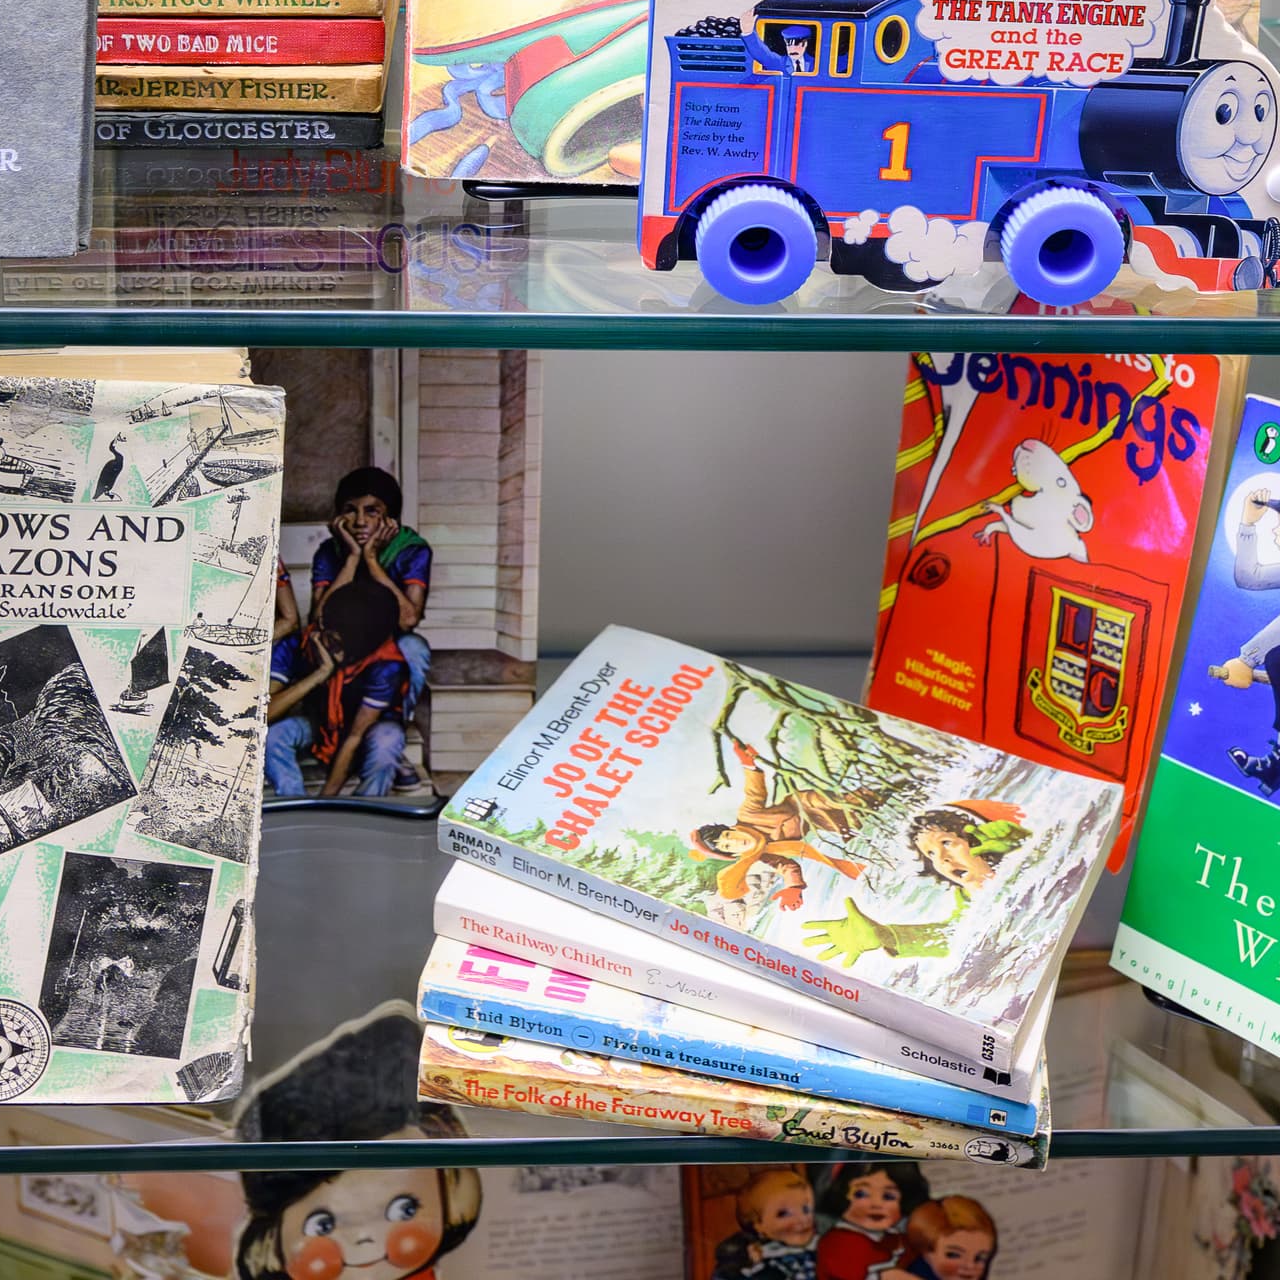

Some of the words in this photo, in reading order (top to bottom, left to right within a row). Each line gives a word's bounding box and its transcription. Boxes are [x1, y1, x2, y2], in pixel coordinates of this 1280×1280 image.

[933, 0, 983, 20] THE
[986, 1, 1052, 23] TANK
[1056, 3, 1146, 27] ENGINE
[122, 35, 170, 52] TWO
[178, 34, 218, 52] BAD
[226, 35, 278, 53] MICE
[991, 28, 1038, 44] and
[1046, 29, 1082, 45] the
[945, 49, 1039, 70] GREAT
[1047, 52, 1124, 73] RACE
[685, 102, 712, 114] Story
[716, 104, 740, 113] from
[683, 132, 710, 141] Series
[712, 133, 726, 144] by
[728, 134, 744, 142] the
[685, 117, 702, 126] The
[704, 118, 742, 130] Railway
[682, 146, 703, 155] Rev.
[708, 147, 720, 156] W.
[723, 149, 759, 160] Awdry
[880, 122, 911, 182] 1
[88, 515, 184, 543] AND
[1, 583, 135, 600] RANSOME
[895, 672, 928, 696] Daily
[931, 686, 973, 711] Mirror
[497, 750, 545, 792] Elinor
[547, 662, 617, 735] Brent-Dyer
[543, 762, 586, 798] JO
[570, 727, 610, 762] OF
[595, 678, 655, 729] THE
[544, 747, 642, 851] CHALET
[625, 664, 715, 749] SCHOOL
[448, 829, 501, 856] ARMADA
[452, 842, 496, 866] BOOKS
[1195, 842, 1276, 917] The
[460, 916, 490, 936] The
[493, 927, 559, 956] Railway
[562, 946, 633, 977] Children
[670, 919, 689, 936] Jo
[693, 928, 712, 942] of
[714, 936, 740, 956] the
[744, 948, 798, 978] Chalet
[801, 969, 860, 1002] School
[465, 1007, 504, 1025] Enid
[509, 1017, 563, 1037] Blyton
[602, 1036, 638, 1053] Five
[642, 1045, 661, 1057] on
[665, 1050, 675, 1060] a
[679, 1051, 747, 1074] treasure
[749, 1064, 801, 1085] island
[901, 1045, 976, 1076] Scholastic
[464, 1079, 499, 1101] The
[503, 1085, 545, 1105] Folk
[549, 1094, 571, 1107] of
[576, 1096, 606, 1113] the
[612, 1098, 706, 1128] Faraway
[710, 1109, 753, 1131] Tree
[782, 1119, 835, 1140] Enid
[842, 1126, 914, 1150] Blyton
[929, 1141, 960, 1151] 33663
